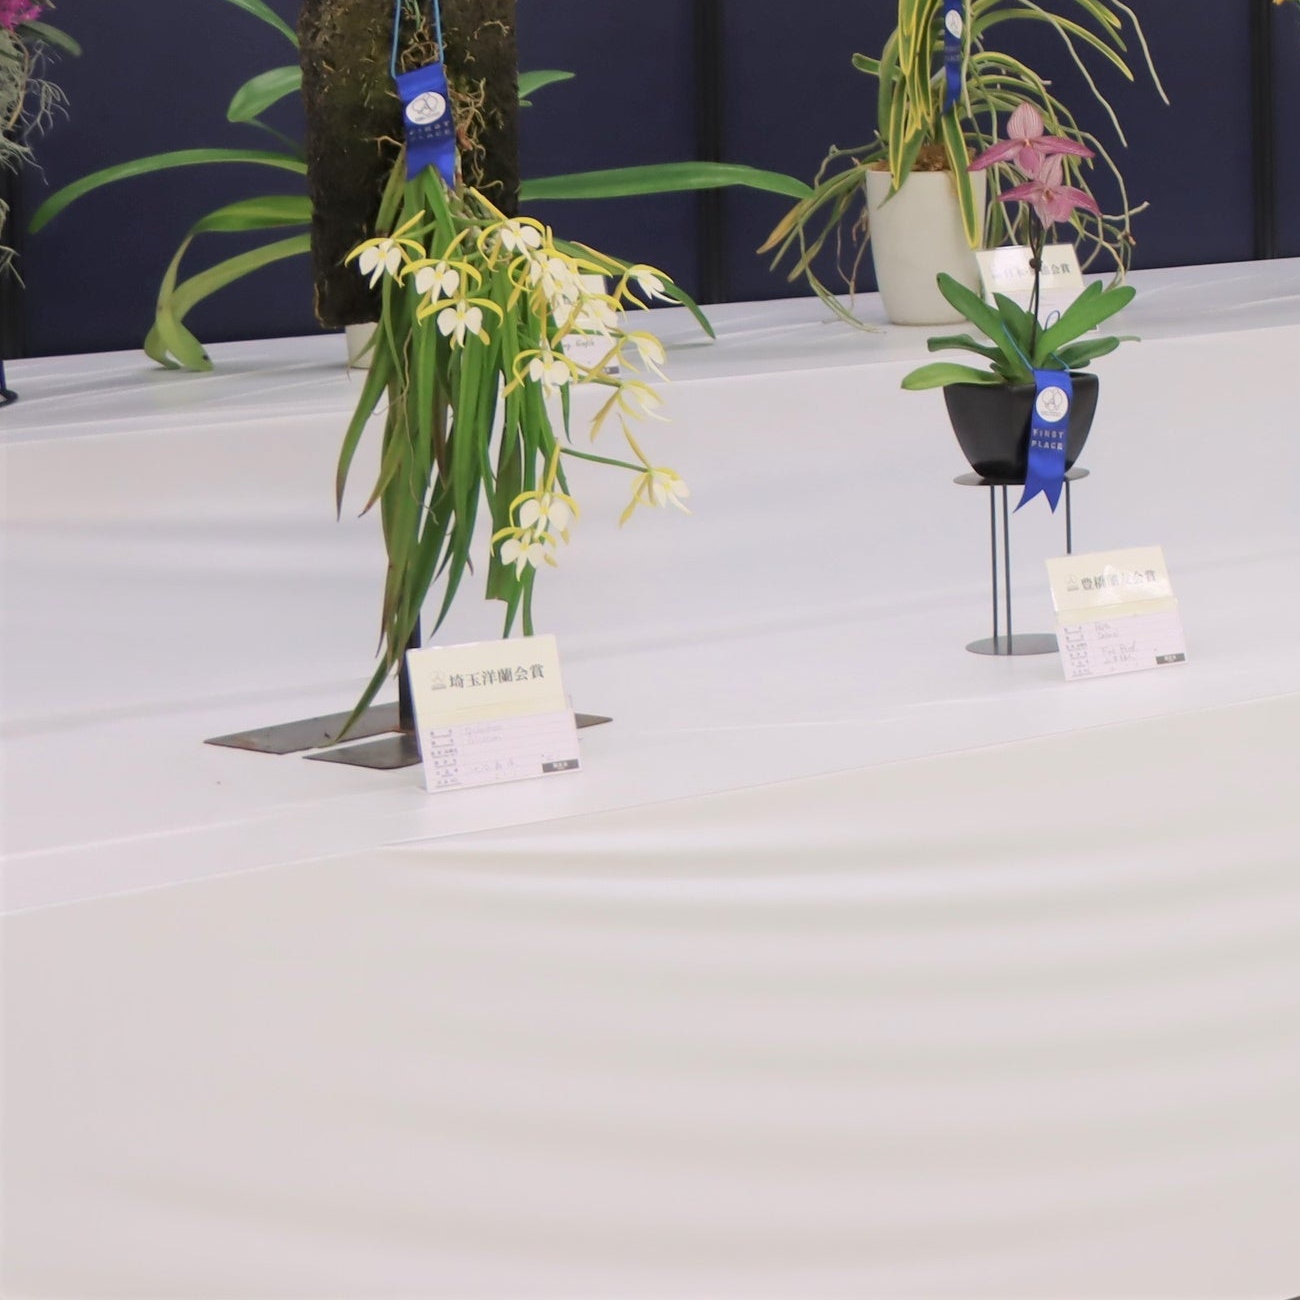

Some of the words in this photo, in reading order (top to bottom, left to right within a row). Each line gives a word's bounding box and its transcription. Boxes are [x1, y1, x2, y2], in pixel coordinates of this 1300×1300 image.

[1032, 427, 1065, 440] FIRST
[1030, 439, 1064, 452] PLACE
[448, 663, 546, 689] 埼玉洋蘭会賞
